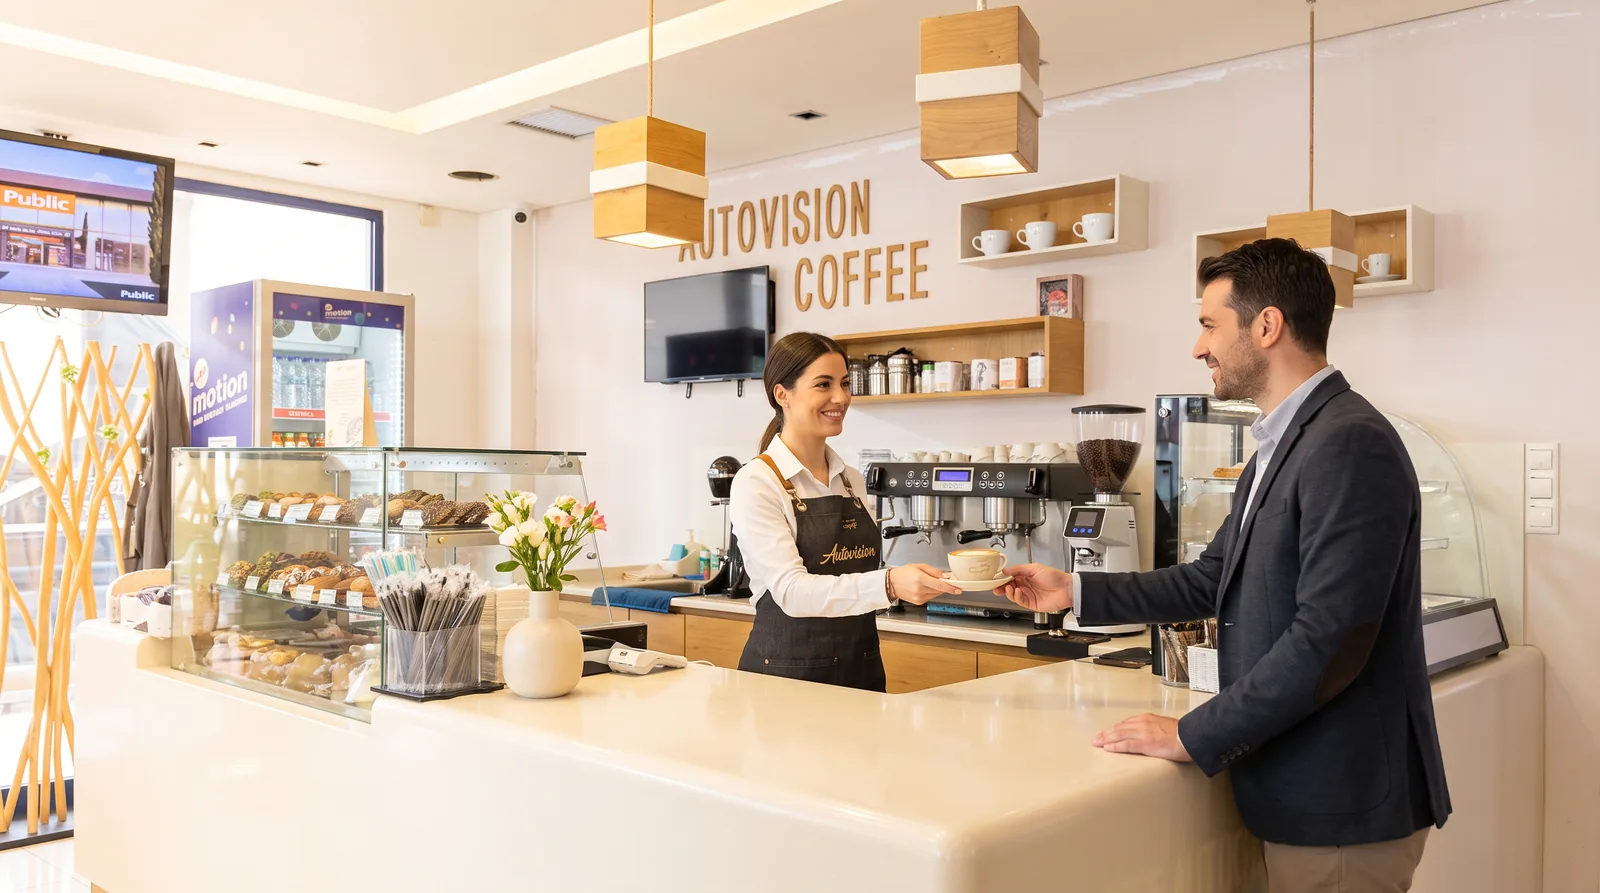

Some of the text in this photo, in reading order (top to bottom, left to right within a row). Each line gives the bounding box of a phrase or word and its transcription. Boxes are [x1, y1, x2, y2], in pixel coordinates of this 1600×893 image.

[4, 189, 70, 211] Public
[794, 240, 929, 312] COFFEE
[120, 289, 155, 300] Public
[325, 308, 352, 317] motion
[192, 370, 248, 416] motion
[819, 543, 876, 565] Autovision
